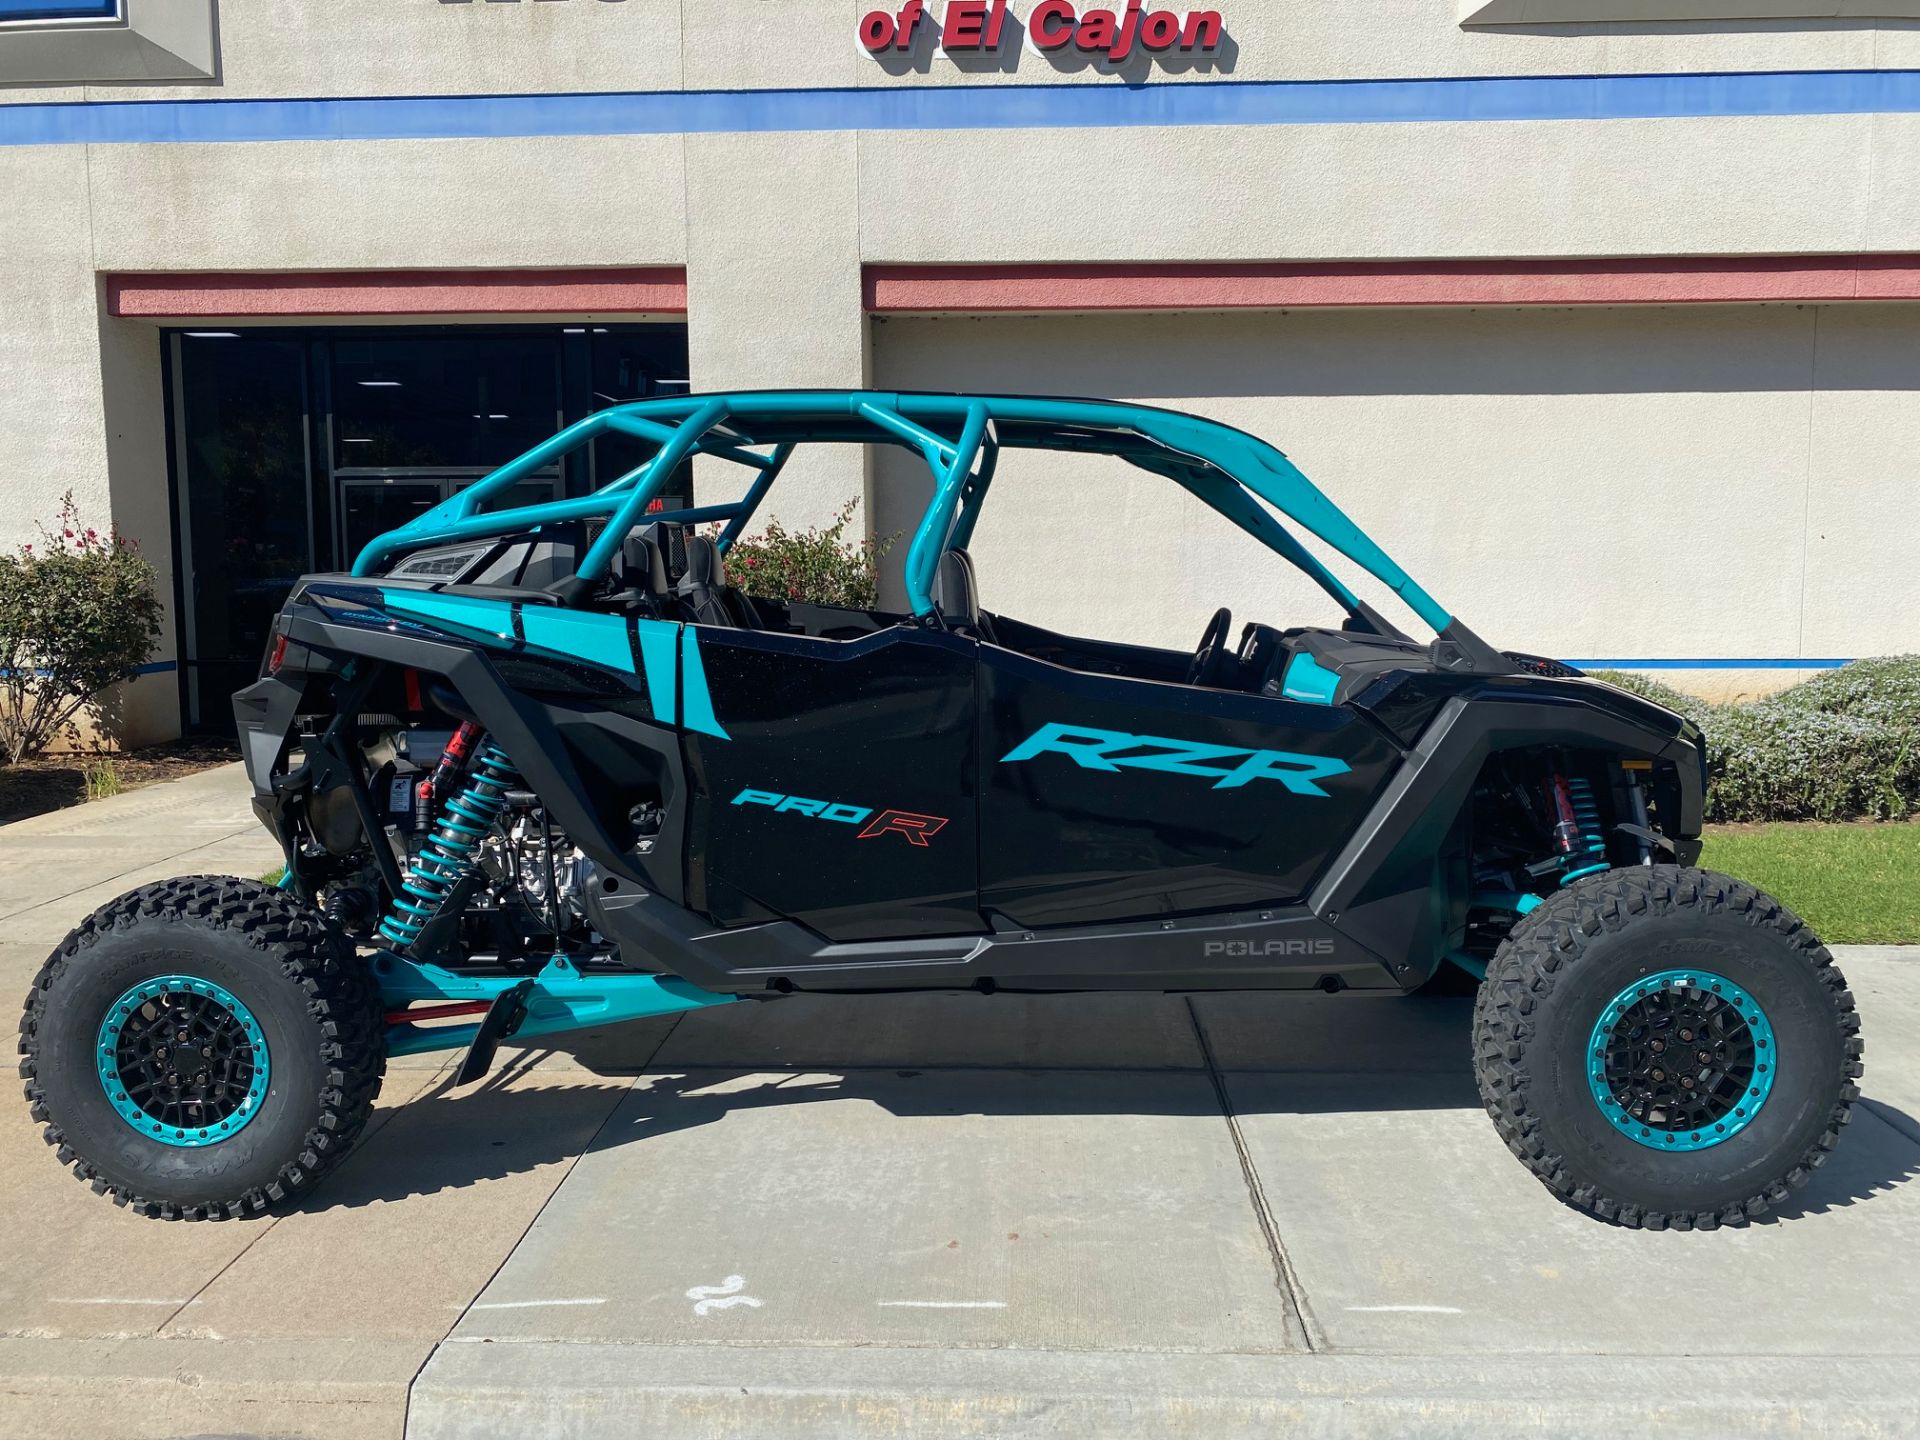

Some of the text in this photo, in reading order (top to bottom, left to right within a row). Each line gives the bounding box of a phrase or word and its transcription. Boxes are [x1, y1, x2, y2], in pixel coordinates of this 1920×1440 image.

[859, 0, 1222, 63] of El Cajon
[1000, 722, 1352, 797] RZR
[730, 788, 874, 824] PRO
[1203, 938, 1336, 957] POLARIS
